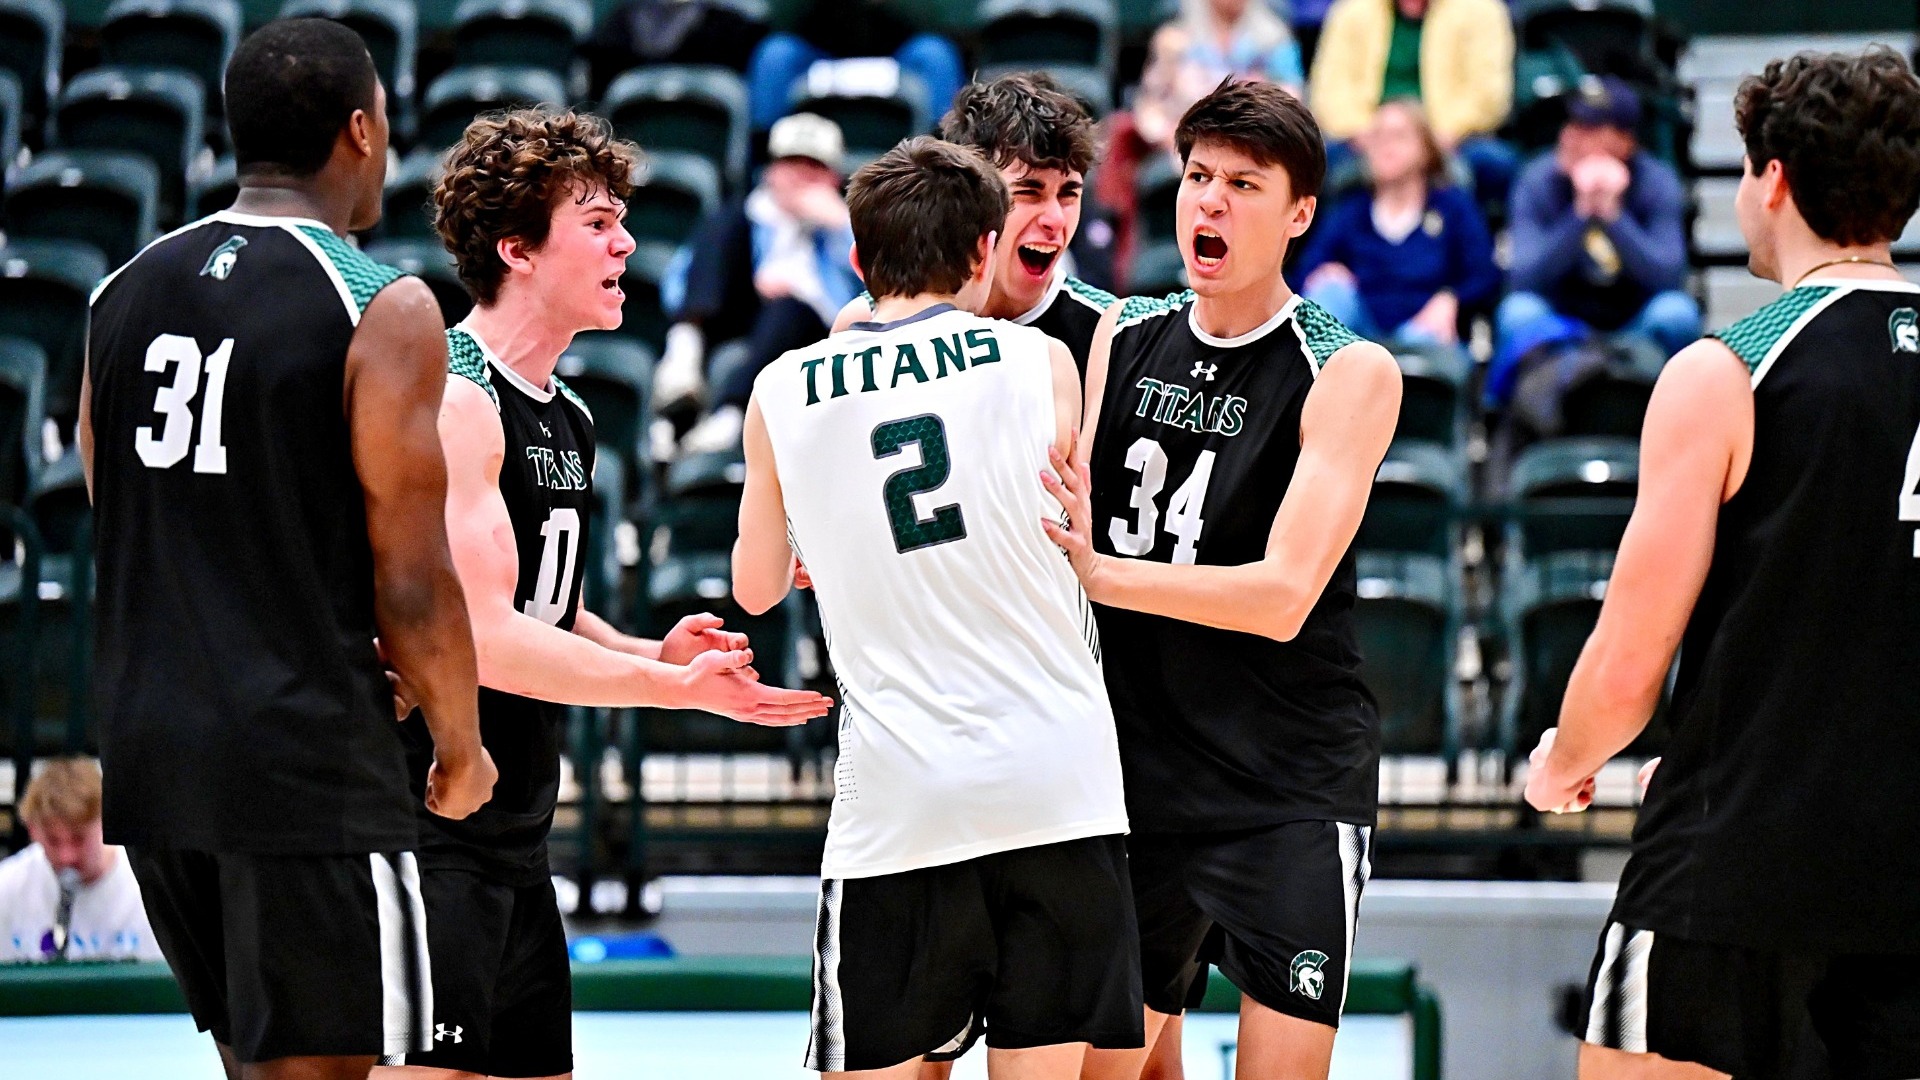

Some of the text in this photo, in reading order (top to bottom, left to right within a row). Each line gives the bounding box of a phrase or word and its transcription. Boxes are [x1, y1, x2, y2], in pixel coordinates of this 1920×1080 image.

[135, 333, 235, 474] 31
[800, 329, 1001, 406] TITANS
[1136, 377, 1248, 436] TITANS
[870, 412, 967, 554] 2
[1108, 437, 1216, 565] 34
